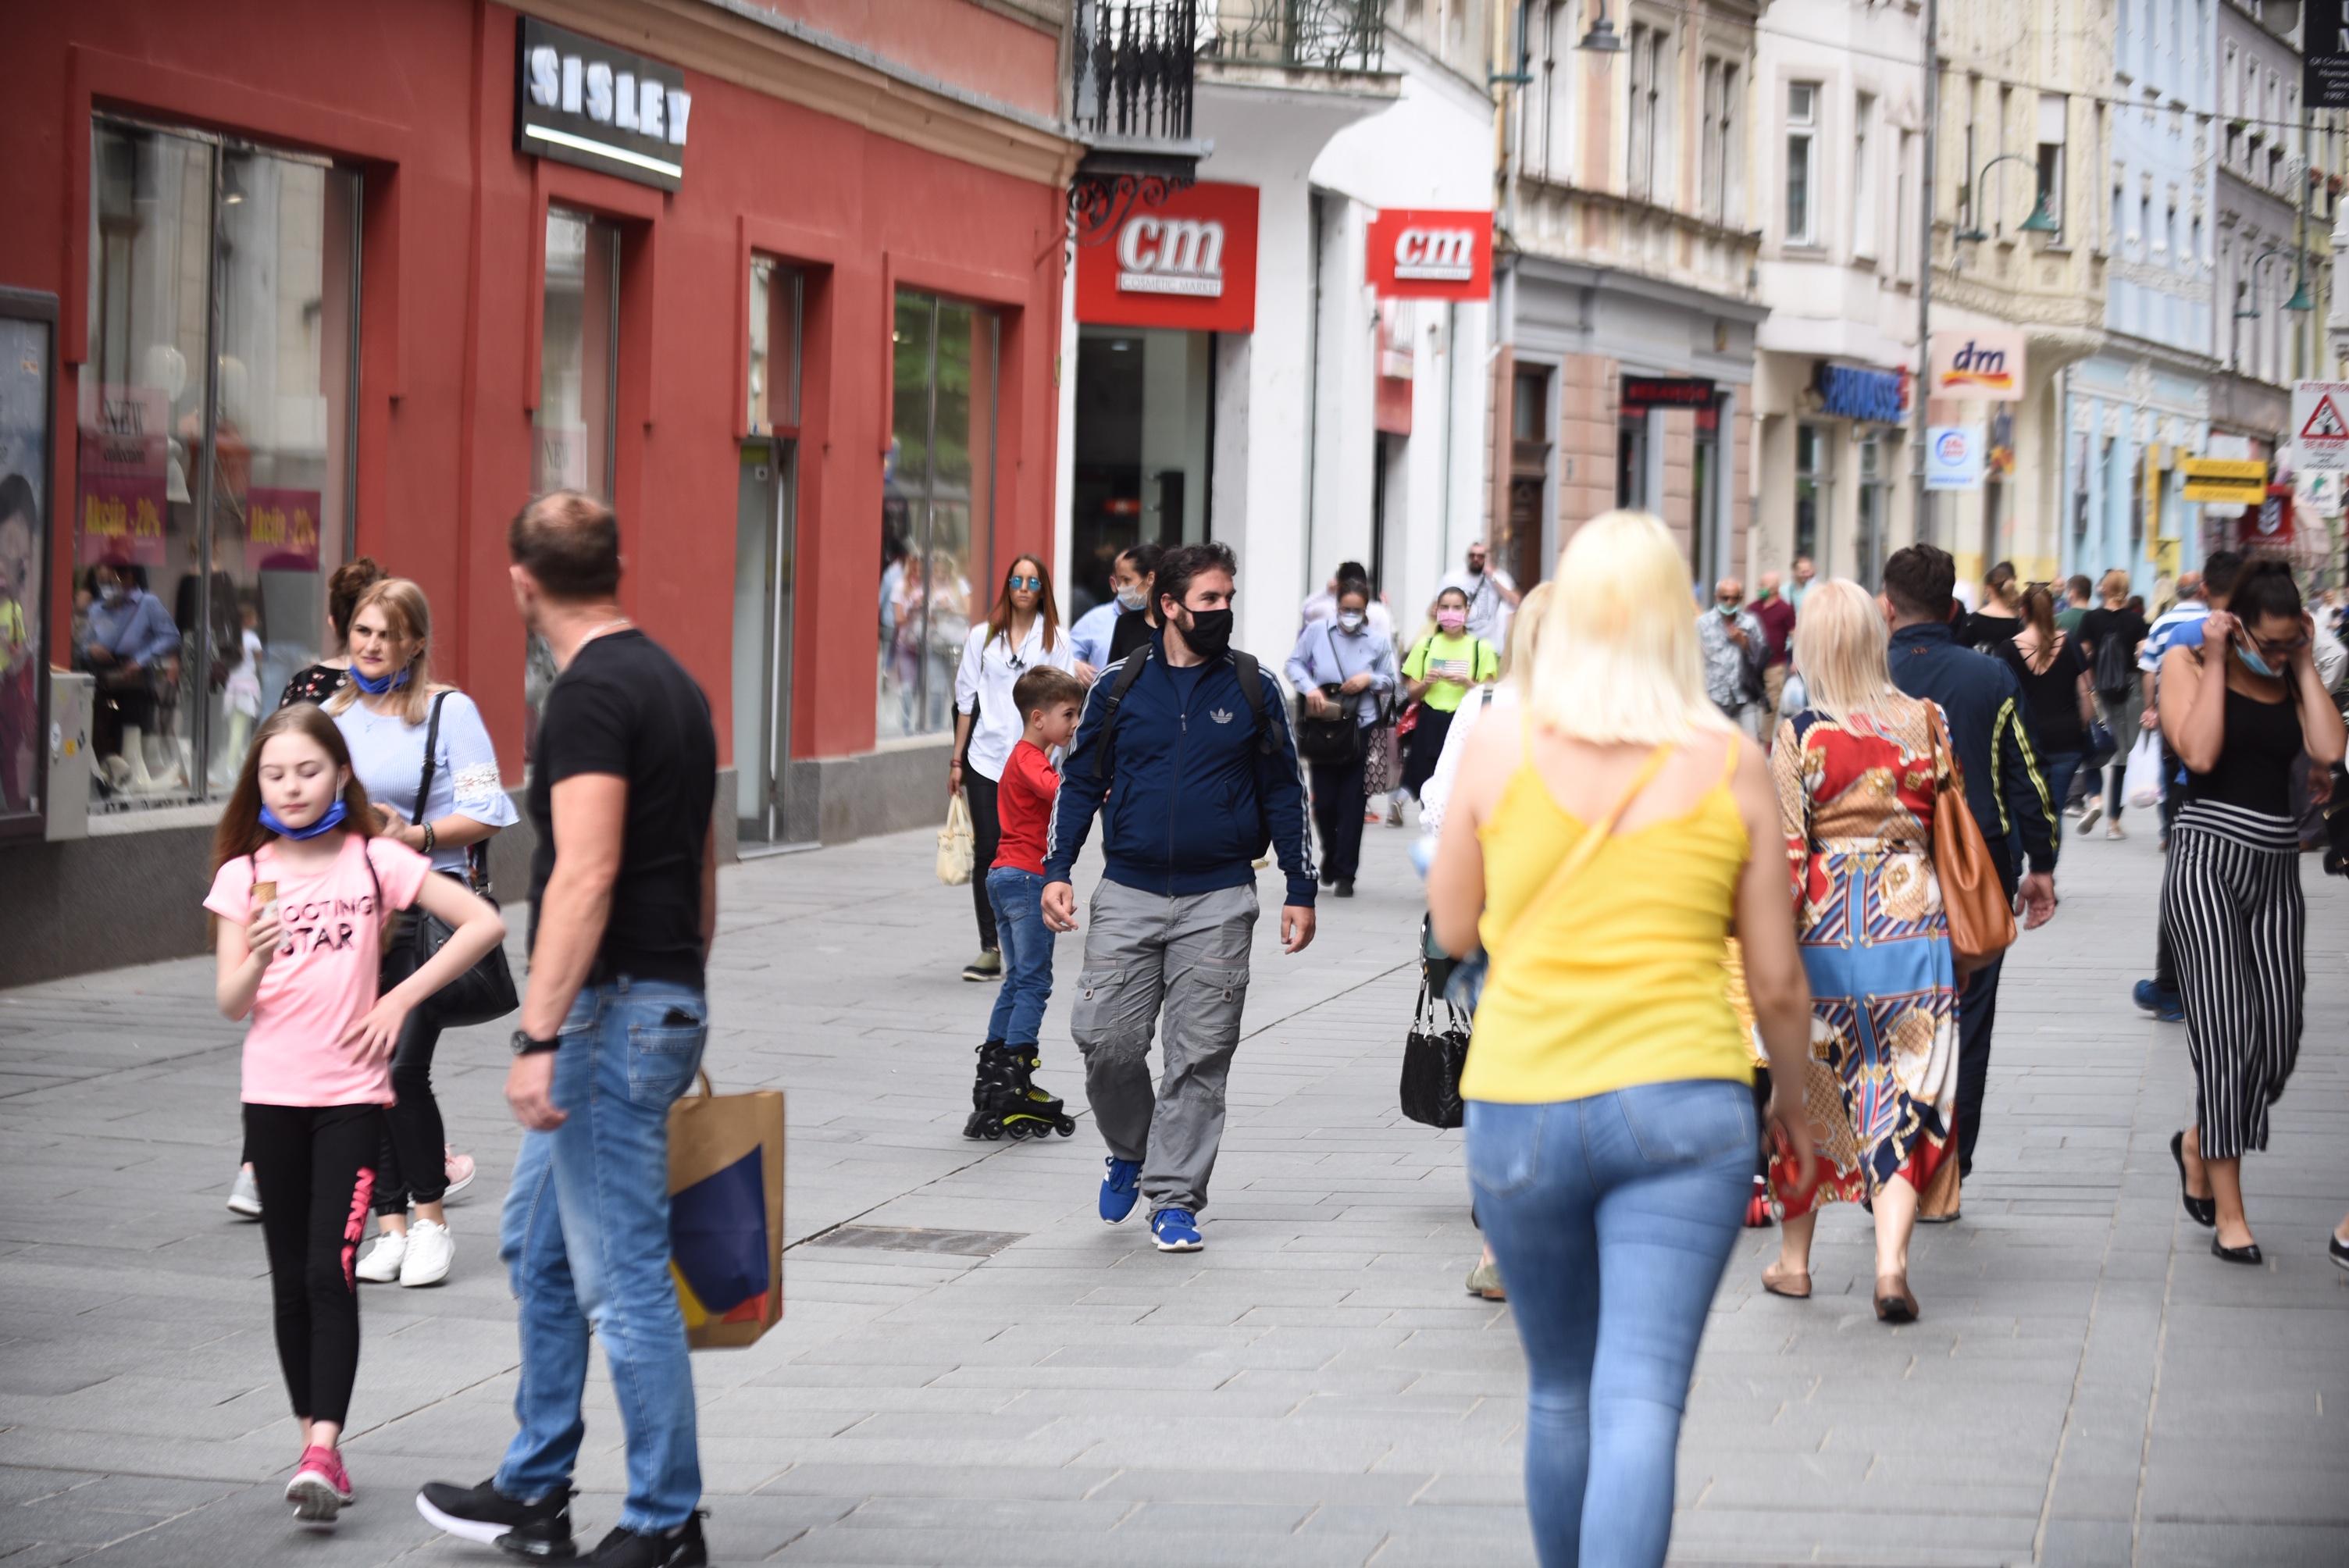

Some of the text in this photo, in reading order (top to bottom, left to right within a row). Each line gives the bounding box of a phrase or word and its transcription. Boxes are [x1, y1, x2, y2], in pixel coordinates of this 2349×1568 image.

[530, 45, 692, 146] SISLEY
[1117, 215, 1224, 275] cm
[1393, 227, 1474, 267] cm
[1121, 275, 1220, 294] COSMETIC MARKET
[1952, 339, 2005, 372] dm
[102, 399, 146, 434] NEW
[283, 896, 373, 923] OOTING
